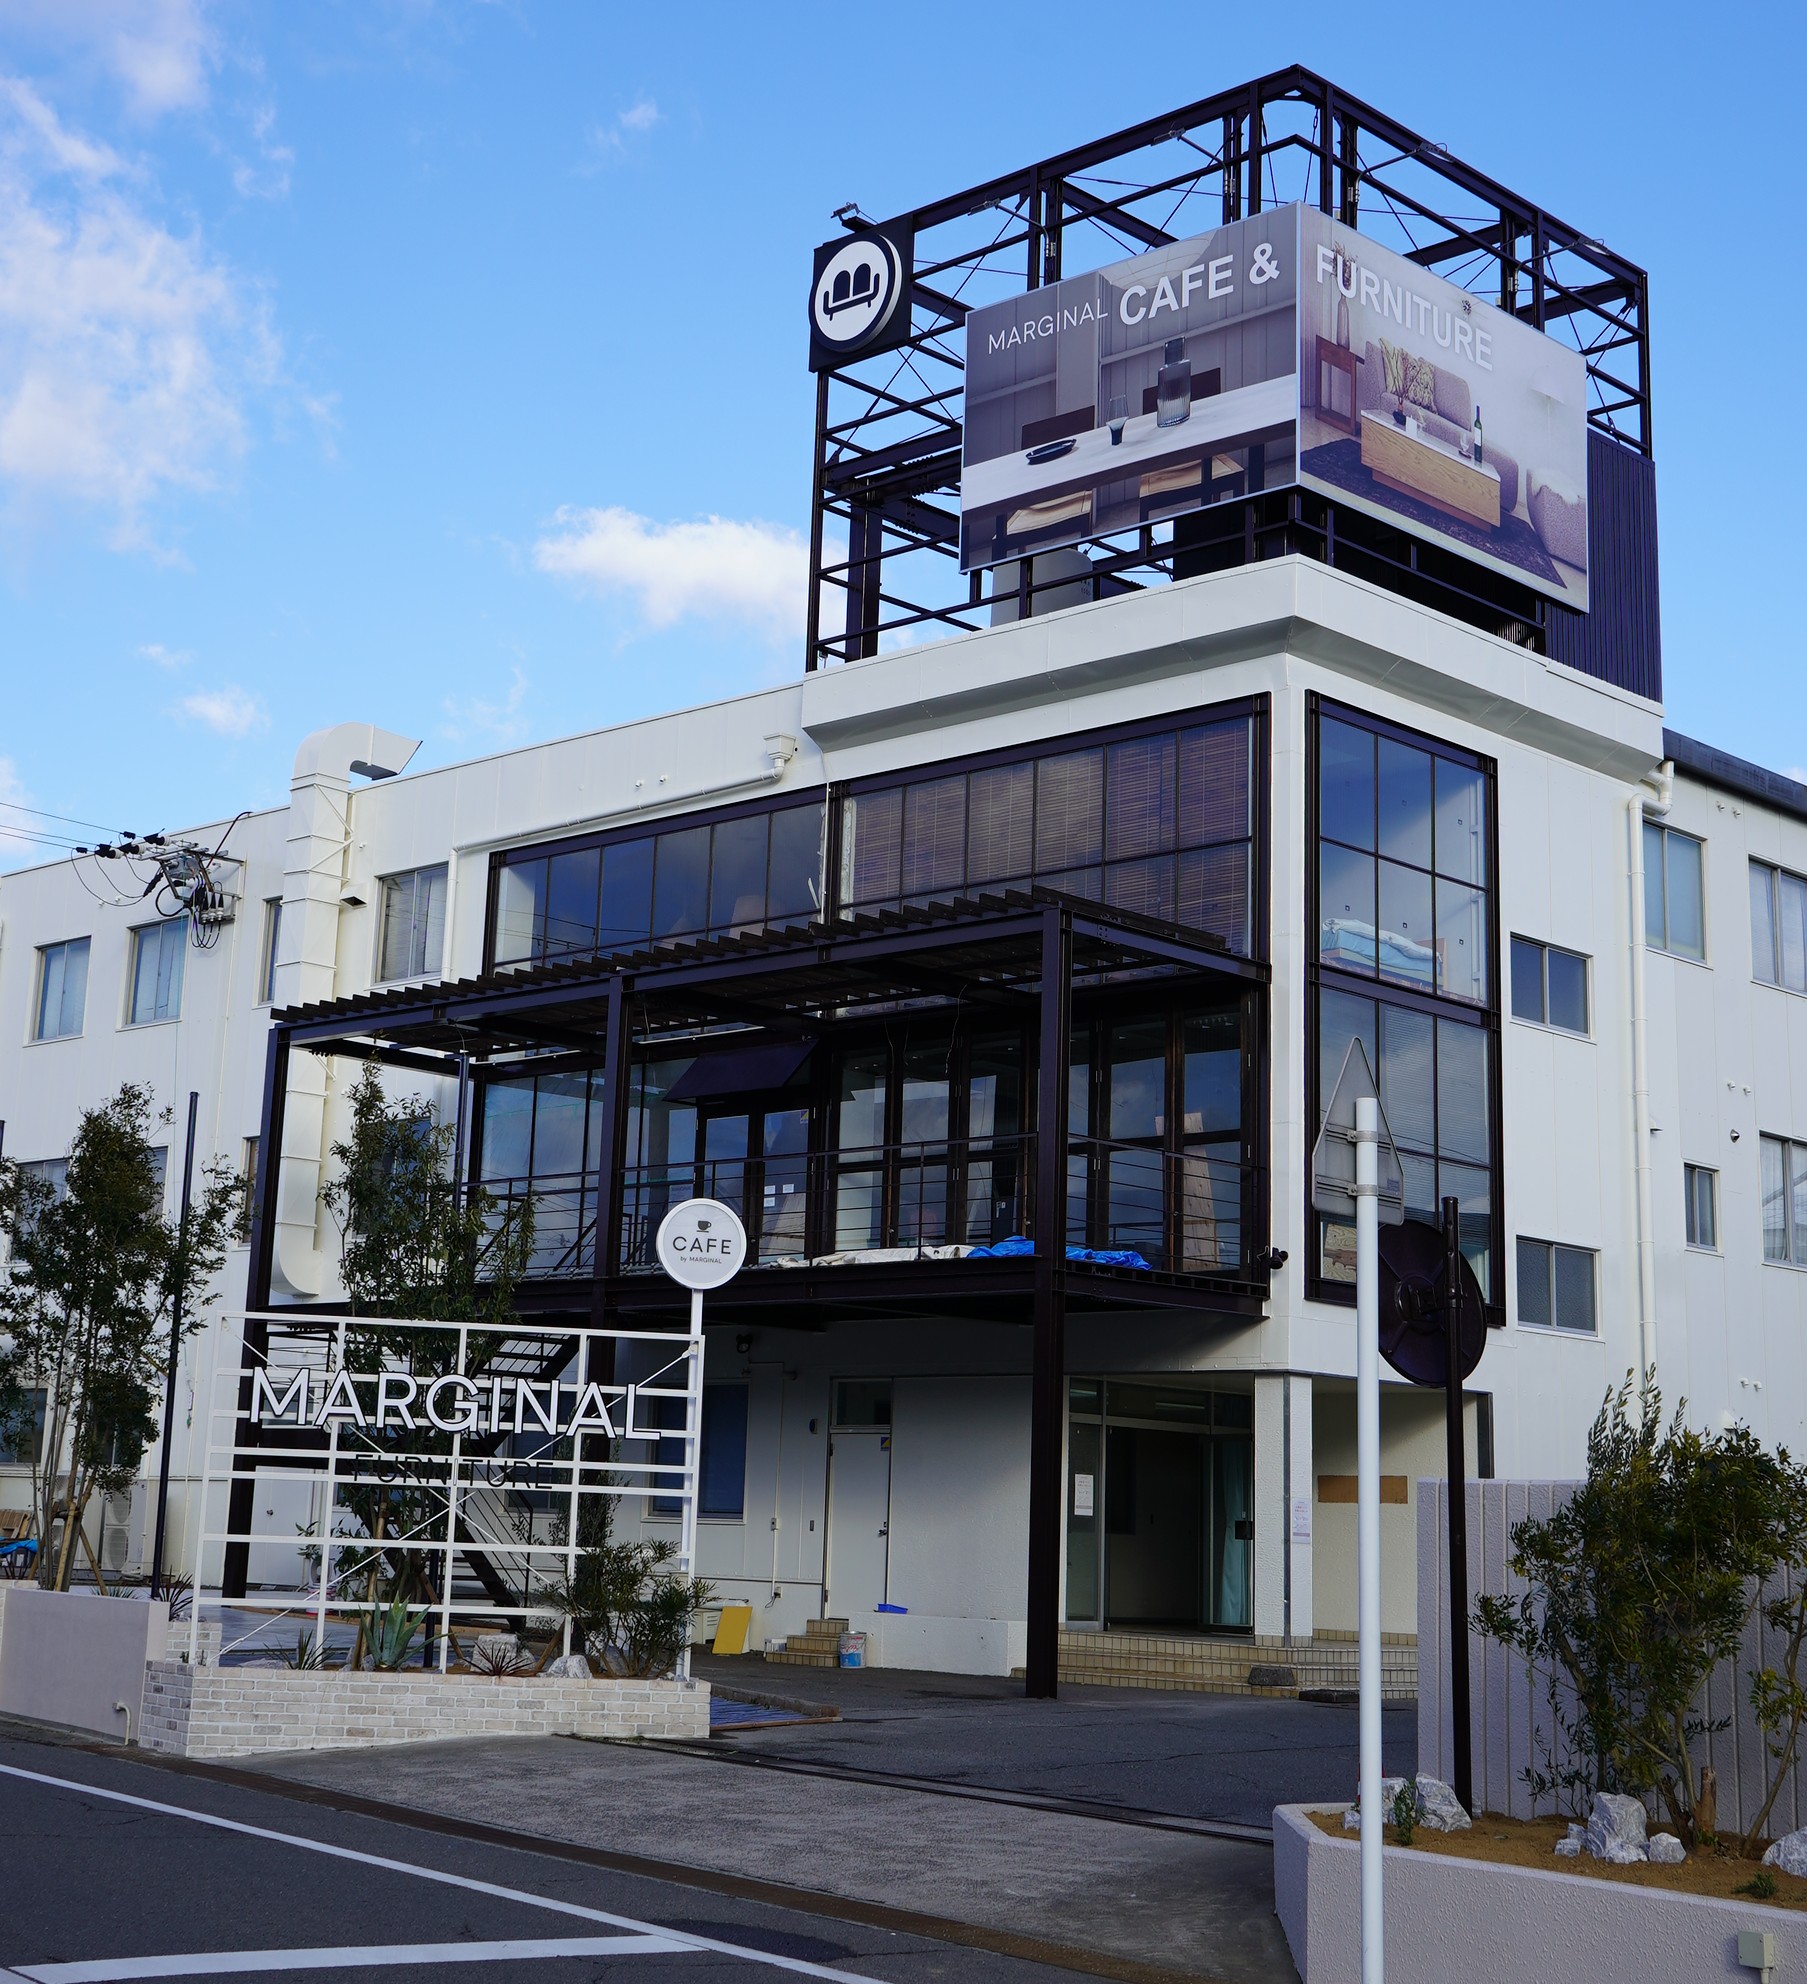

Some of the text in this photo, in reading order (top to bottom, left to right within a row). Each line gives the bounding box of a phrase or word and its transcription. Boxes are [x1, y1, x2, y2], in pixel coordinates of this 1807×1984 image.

[988, 242, 1280, 354] MARGINAL CAFE &
[1316, 244, 1493, 371] FURNITURE
[672, 1236, 732, 1254] CAFE
[689, 1256, 722, 1264] MARGINAL
[250, 1366, 661, 1441] MARGINAL
[354, 1453, 554, 1490] FURNITURE
